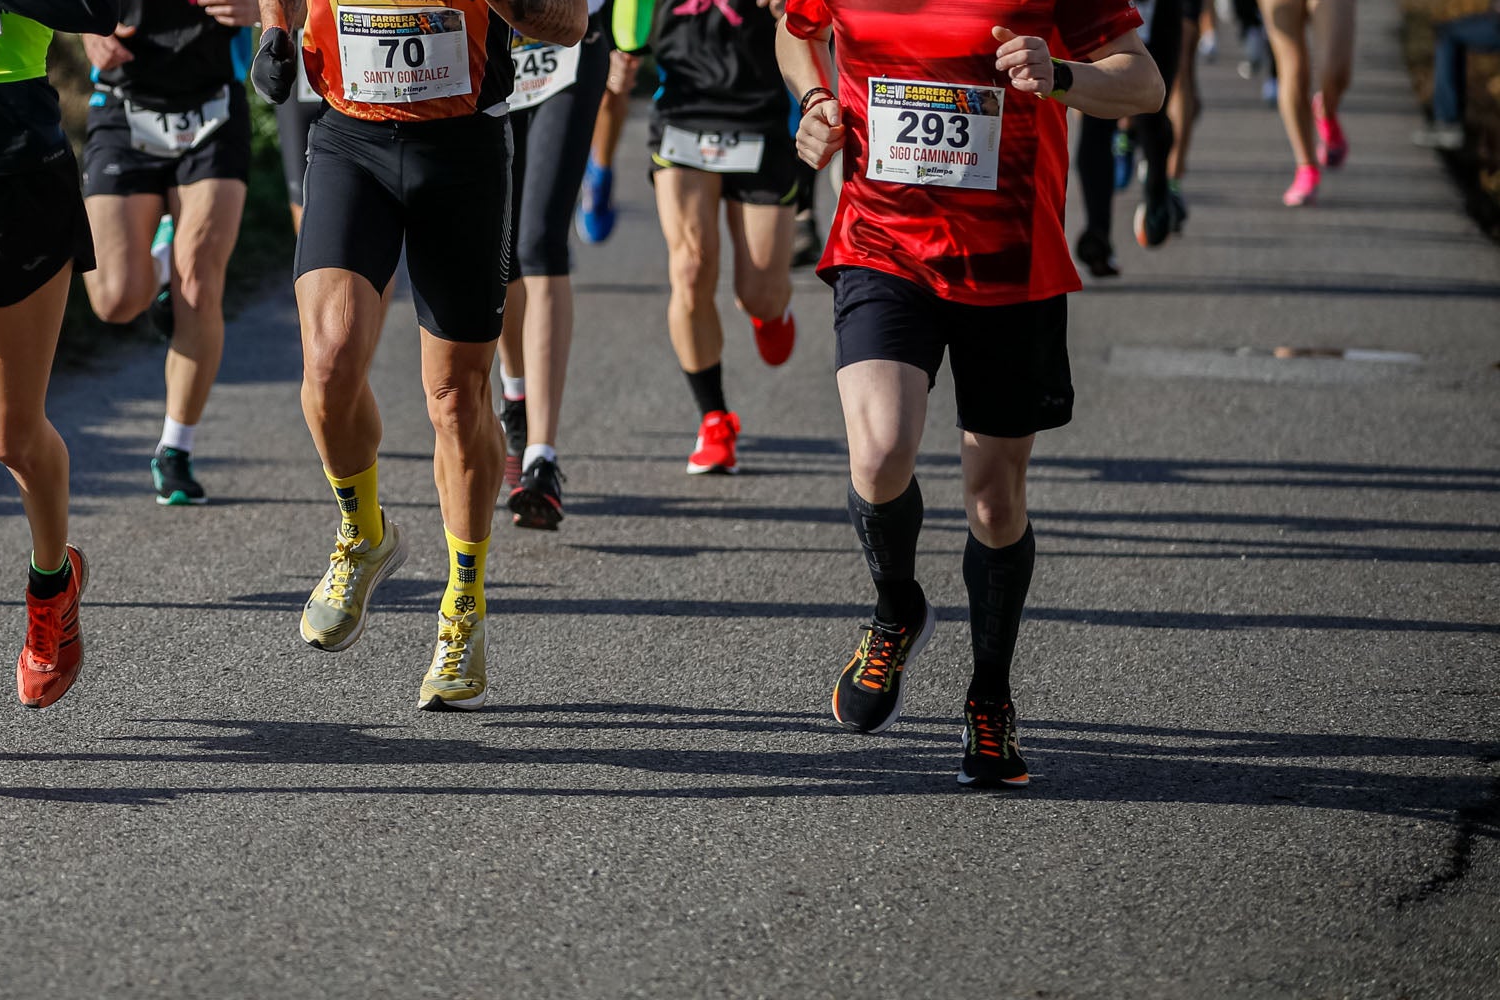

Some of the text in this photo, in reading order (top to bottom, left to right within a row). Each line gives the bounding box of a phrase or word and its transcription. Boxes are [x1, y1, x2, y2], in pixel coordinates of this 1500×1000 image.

[344, 13, 354, 23] 26
[371, 14, 416, 23] CARRERA
[378, 38, 425, 68] 70
[364, 66, 450, 84] SANTY GONZALEZ
[875, 84, 887, 94] 26
[905, 85, 954, 97] CARRERA
[905, 93, 954, 103] POPULAR
[902, 100, 931, 108] Secaderos
[896, 111, 970, 148] 293
[889, 145, 978, 166] SIGO CAMINANDO
